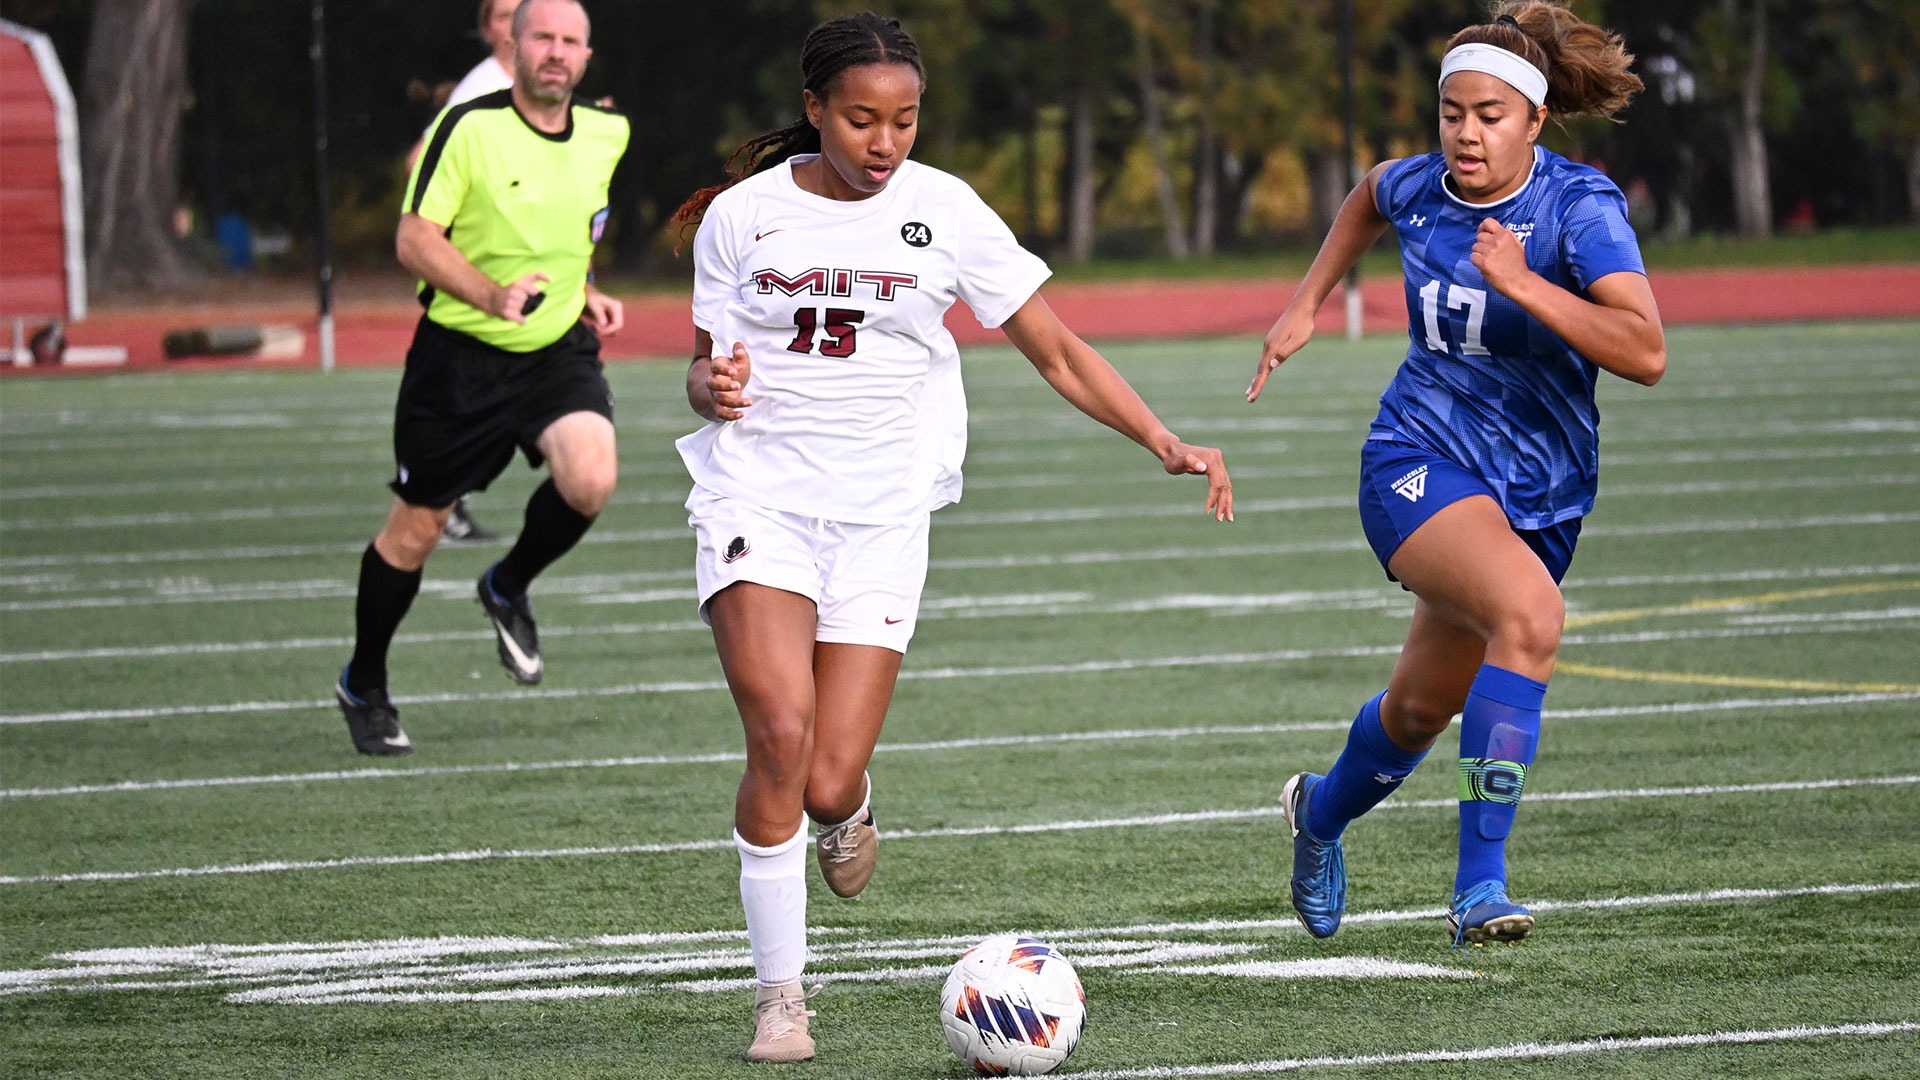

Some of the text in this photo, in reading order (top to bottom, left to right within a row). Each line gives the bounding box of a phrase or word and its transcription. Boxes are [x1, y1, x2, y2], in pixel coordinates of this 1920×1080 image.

[904, 225, 928, 243] 24
[751, 267, 918, 301] MIT
[786, 307, 865, 358] 15
[1419, 279, 1491, 356] 17
[1390, 464, 1428, 490] WELLESLEY
[1484, 769, 1518, 795] C
